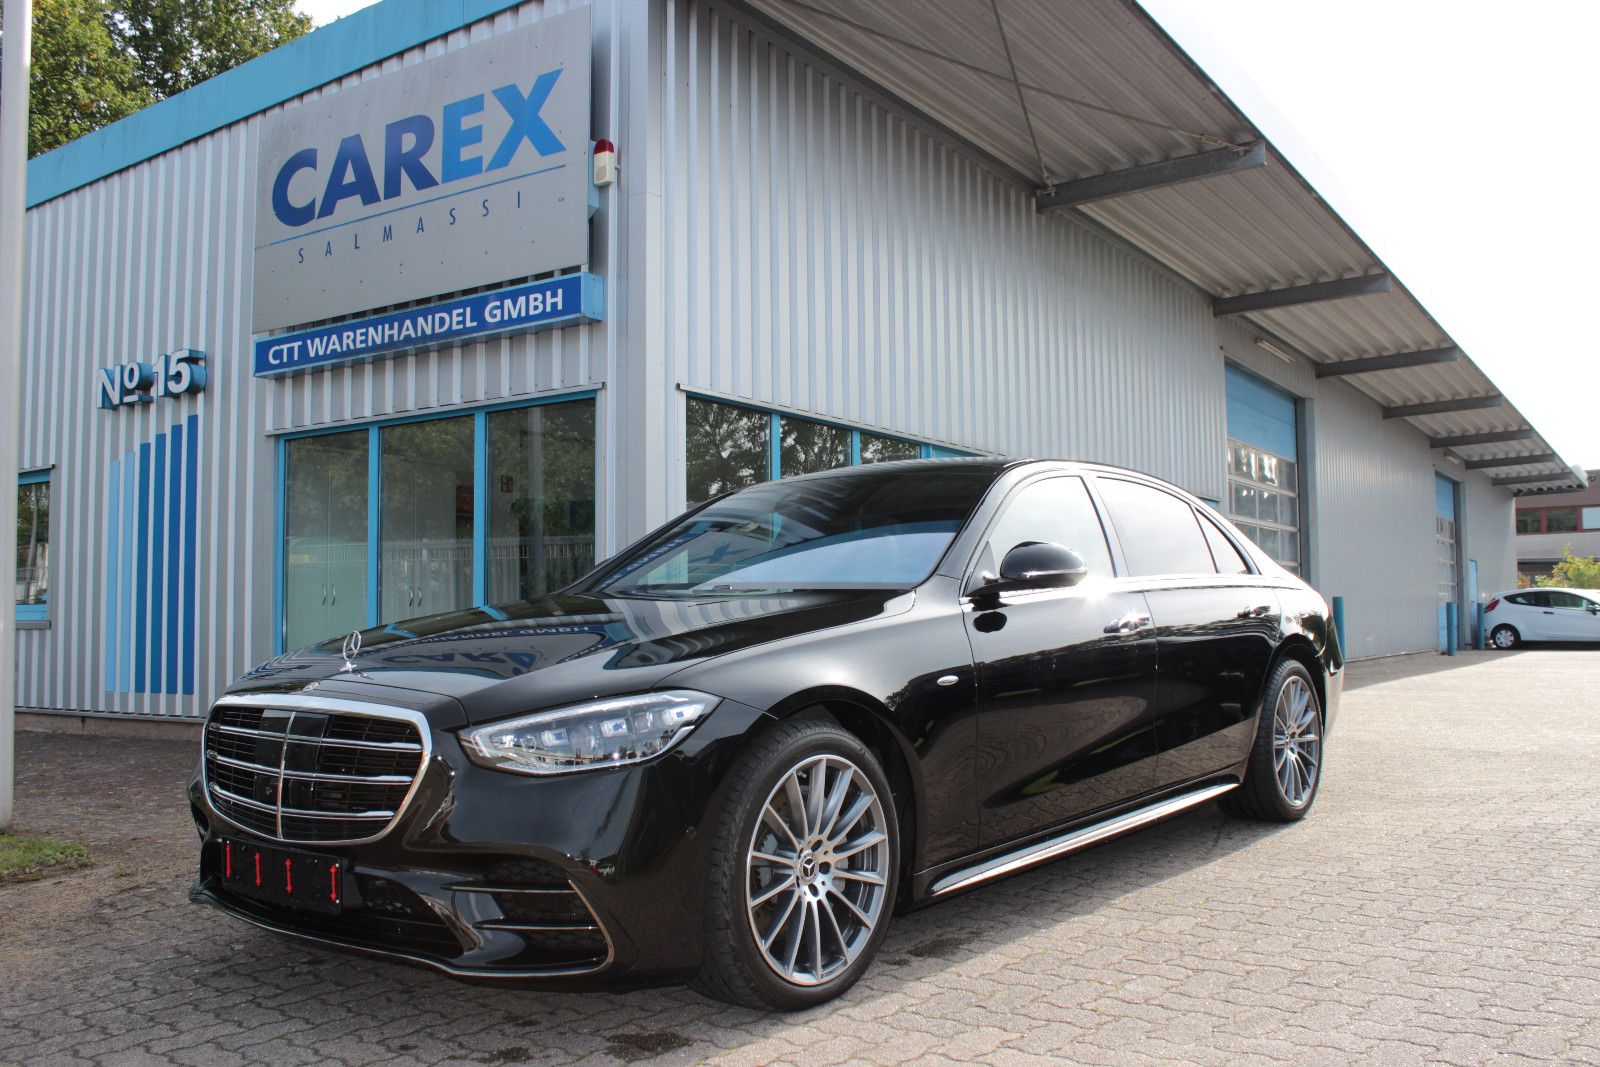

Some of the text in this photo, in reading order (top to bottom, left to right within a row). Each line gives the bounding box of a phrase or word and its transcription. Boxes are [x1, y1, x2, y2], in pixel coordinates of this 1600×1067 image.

[271, 68, 567, 227] CAREX
[298, 191, 521, 264] SALMASSI
[267, 288, 564, 365] CTT WARENHANDEL GMBH
[152, 349, 191, 397] 15
